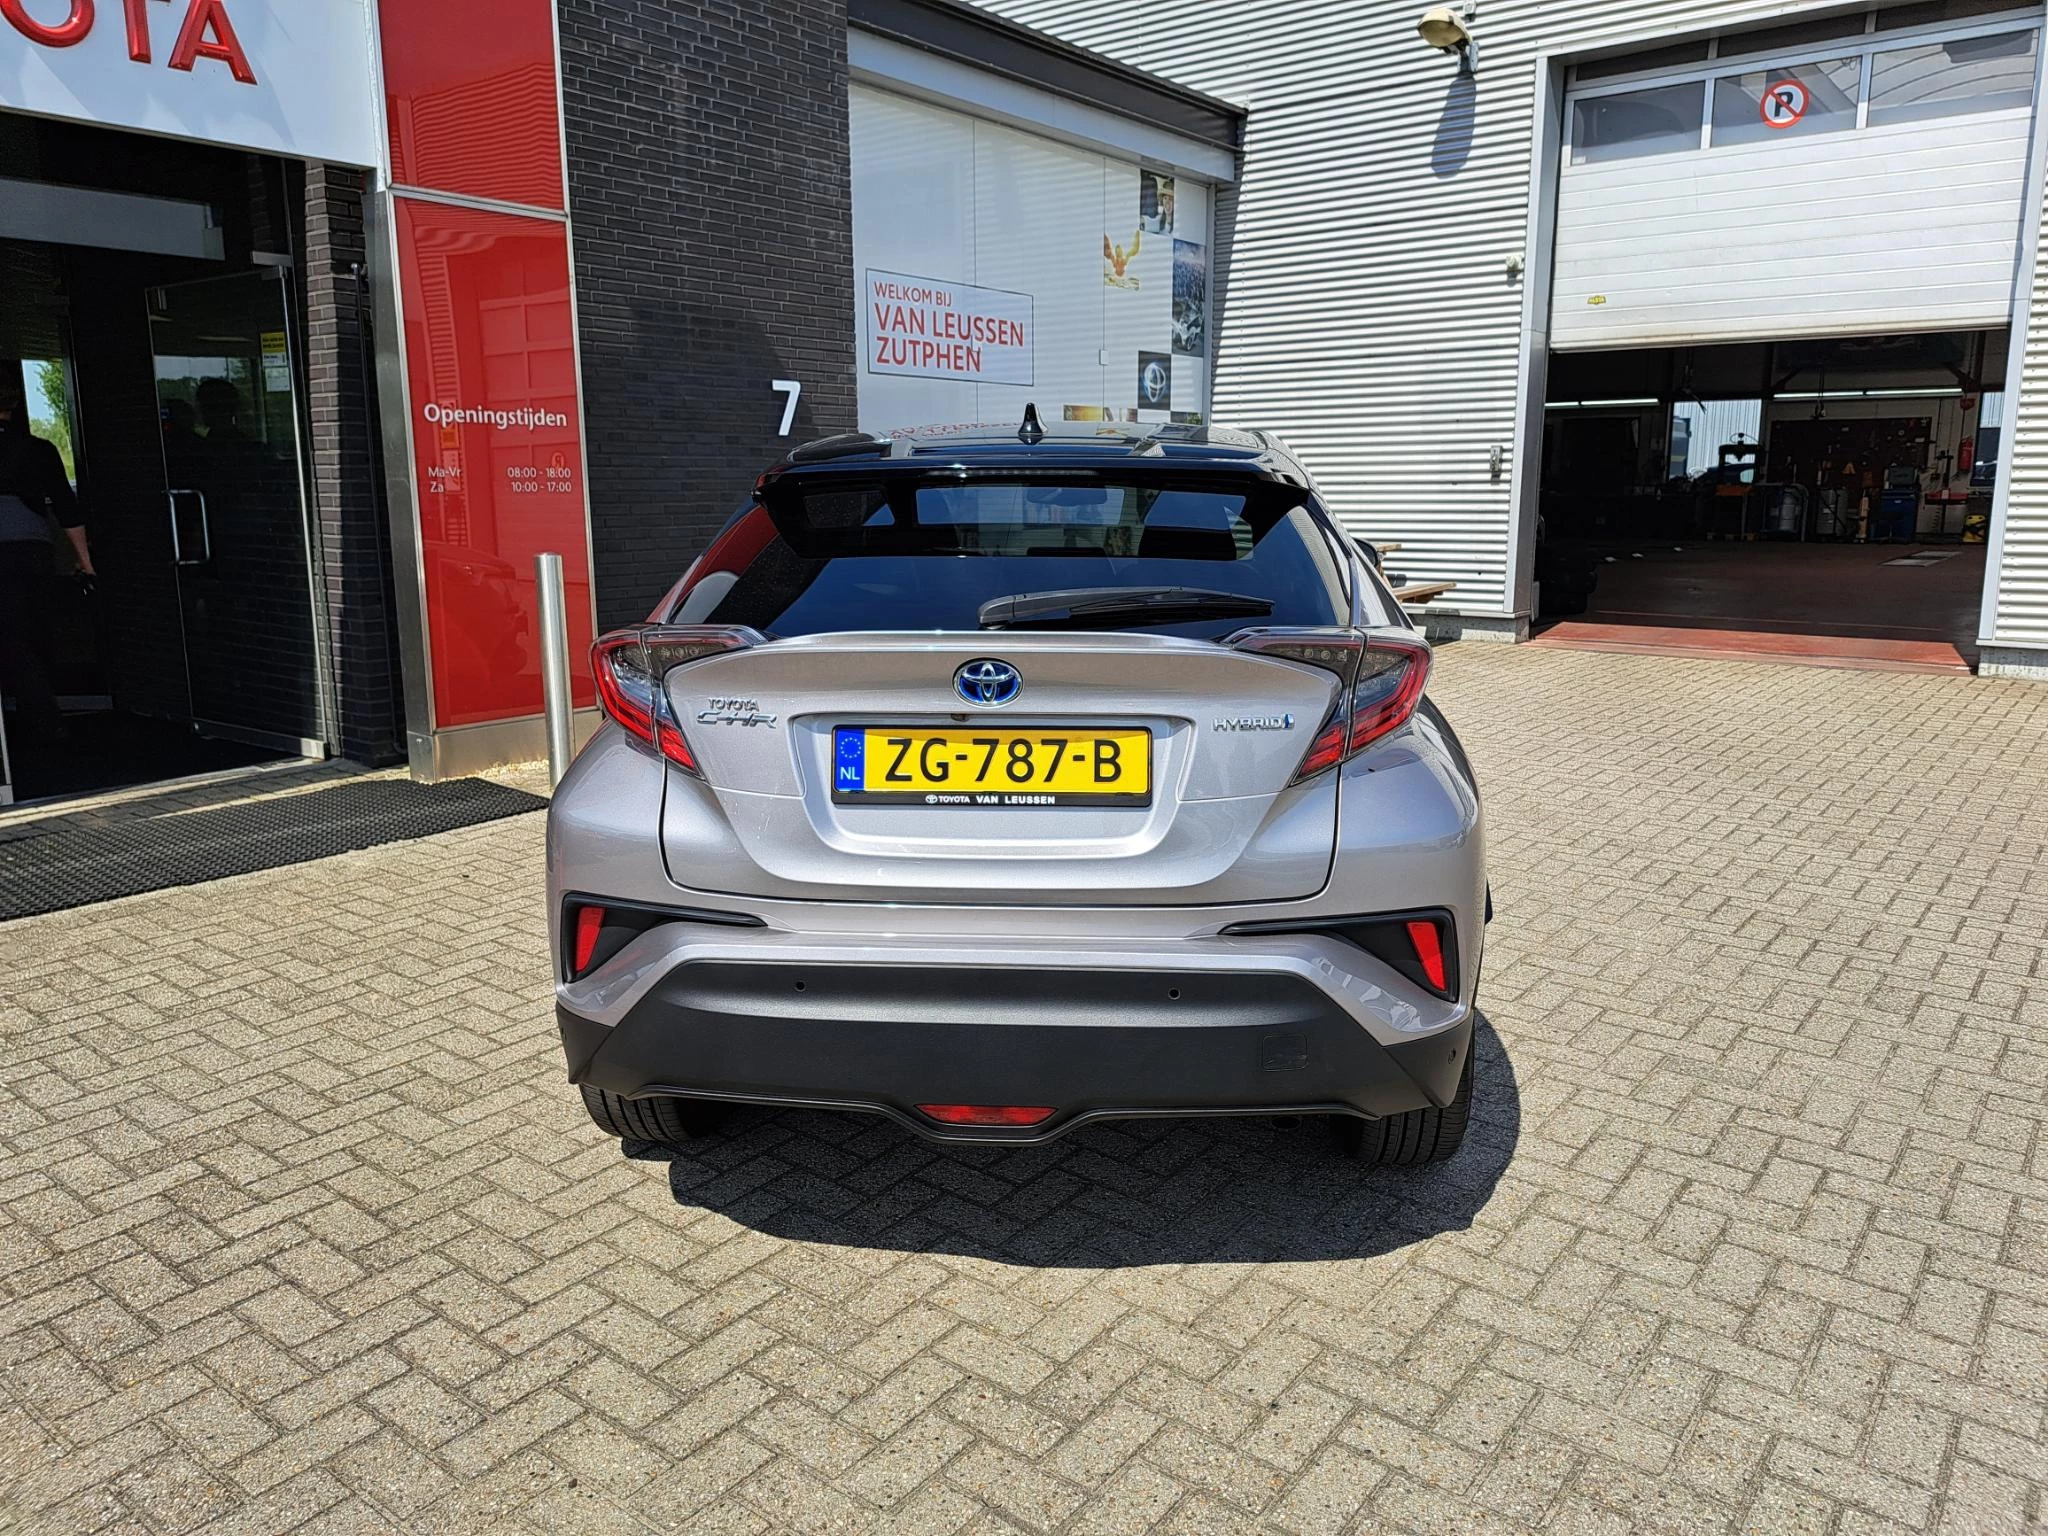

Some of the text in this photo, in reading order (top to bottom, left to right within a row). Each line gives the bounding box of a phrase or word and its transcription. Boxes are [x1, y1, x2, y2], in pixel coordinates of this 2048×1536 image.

[874, 281, 952, 307] WELKOM BIJ
[874, 302, 1024, 347] VAN LEUSSEN
[876, 336, 981, 373] ZUTPHEN
[423, 402, 568, 430] Openingstijden
[772, 379, 801, 436] 7
[428, 466, 462, 478] Ma-Vr
[507, 467, 537, 478] 08:00
[545, 467, 571, 478] 18:00
[430, 481, 445, 493] Za
[511, 481, 538, 492] 10:00
[547, 481, 572, 492] 17:00
[707, 697, 760, 712] TOYOTA
[696, 710, 777, 729] C-HR
[1212, 715, 1283, 732] HYBRID
[884, 737, 1122, 784] ZG-787-B
[840, 766, 861, 781] NL
[938, 795, 1056, 805] TOYOTA VAN LEUSSEN
